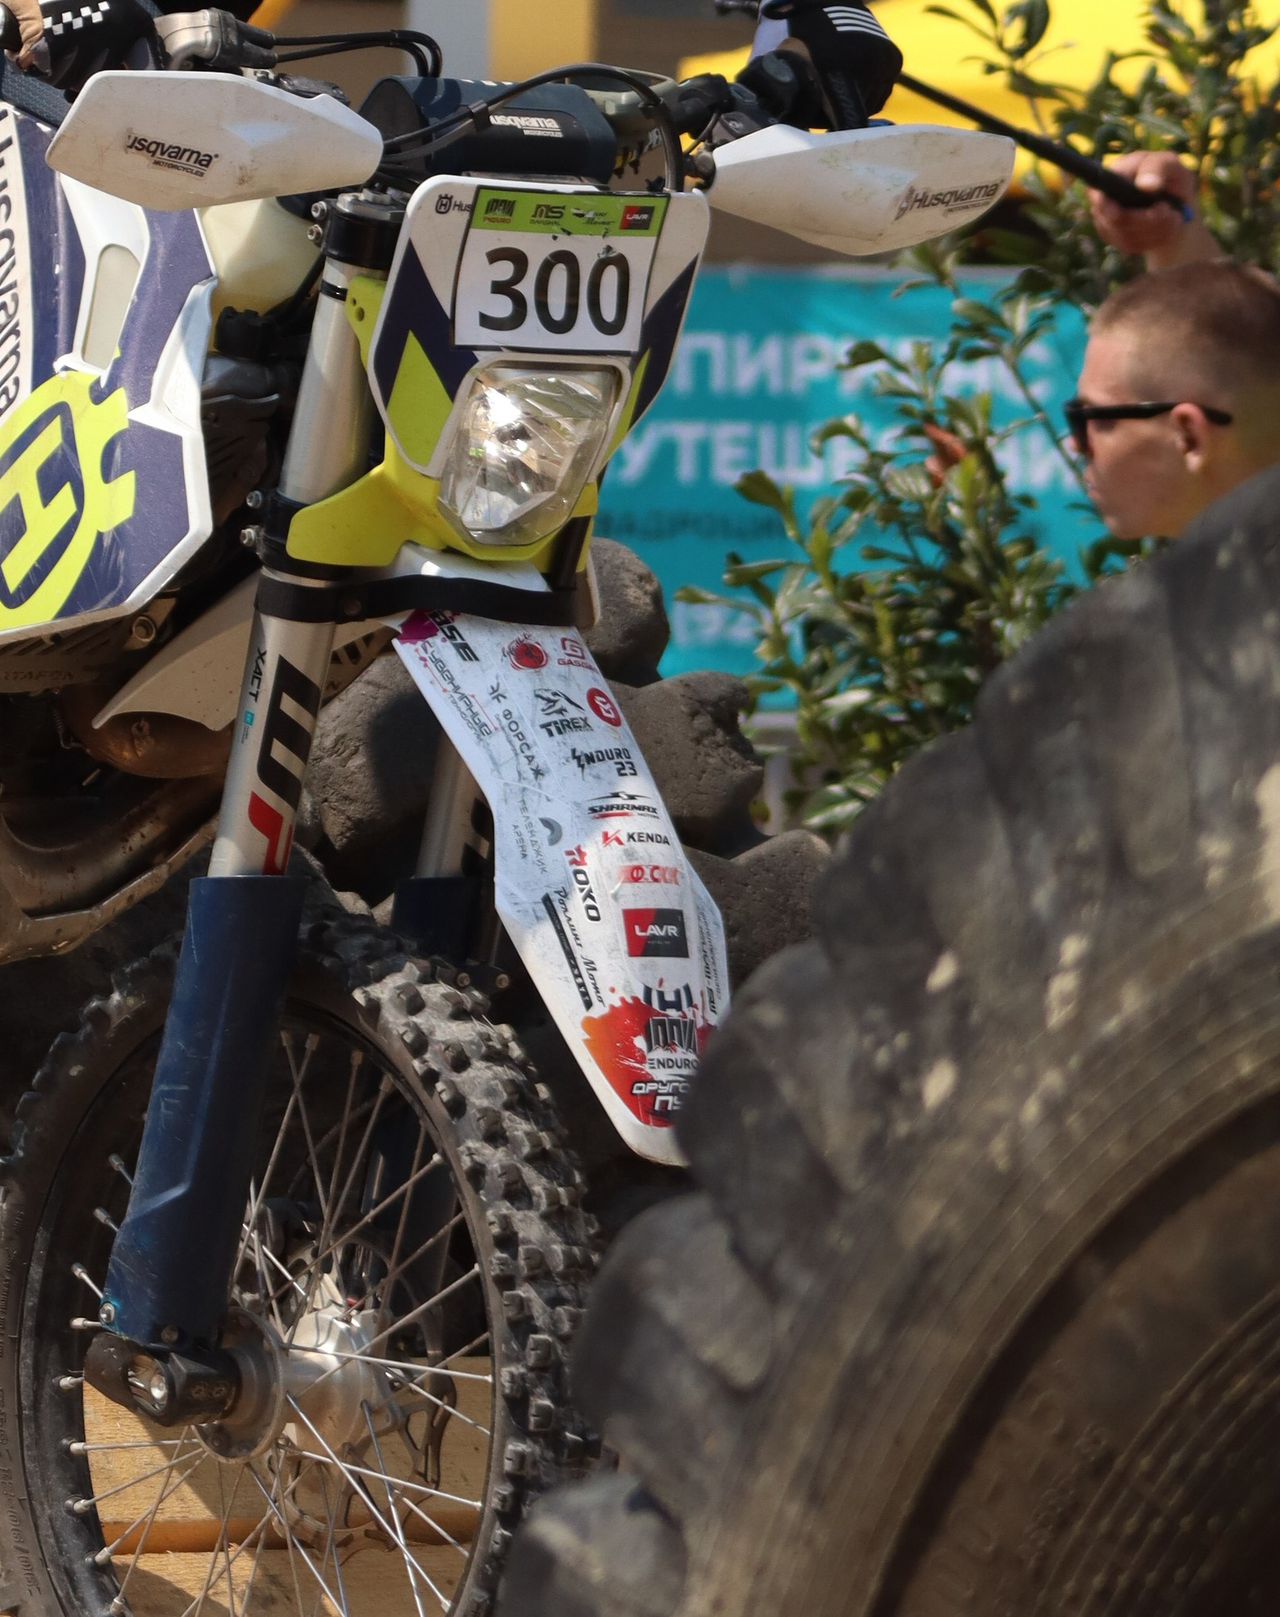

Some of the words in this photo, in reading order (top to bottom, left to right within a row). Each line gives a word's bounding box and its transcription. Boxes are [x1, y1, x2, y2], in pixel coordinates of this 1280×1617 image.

[488, 114, 561, 129] usqvarna
[126, 134, 217, 170] usqvarna
[152, 159, 206, 178] MOTORCYCLES
[908, 182, 1000, 211] Husqvarna
[626, 213, 649, 221] LAVR
[478, 245, 631, 336] 300
[249, 645, 268, 704] XACT
[502, 709, 545, 780] ФОРСАЖ
[614, 760, 638, 777] 23
[587, 803, 659, 816] SHARMAX
[627, 832, 671, 846] KENDA
[634, 923, 679, 938] LAVR
[581, 954, 607, 1008] Мото
[631, 1081, 692, 1095] ДРУГО
[653, 1094, 682, 1111] ПУ
